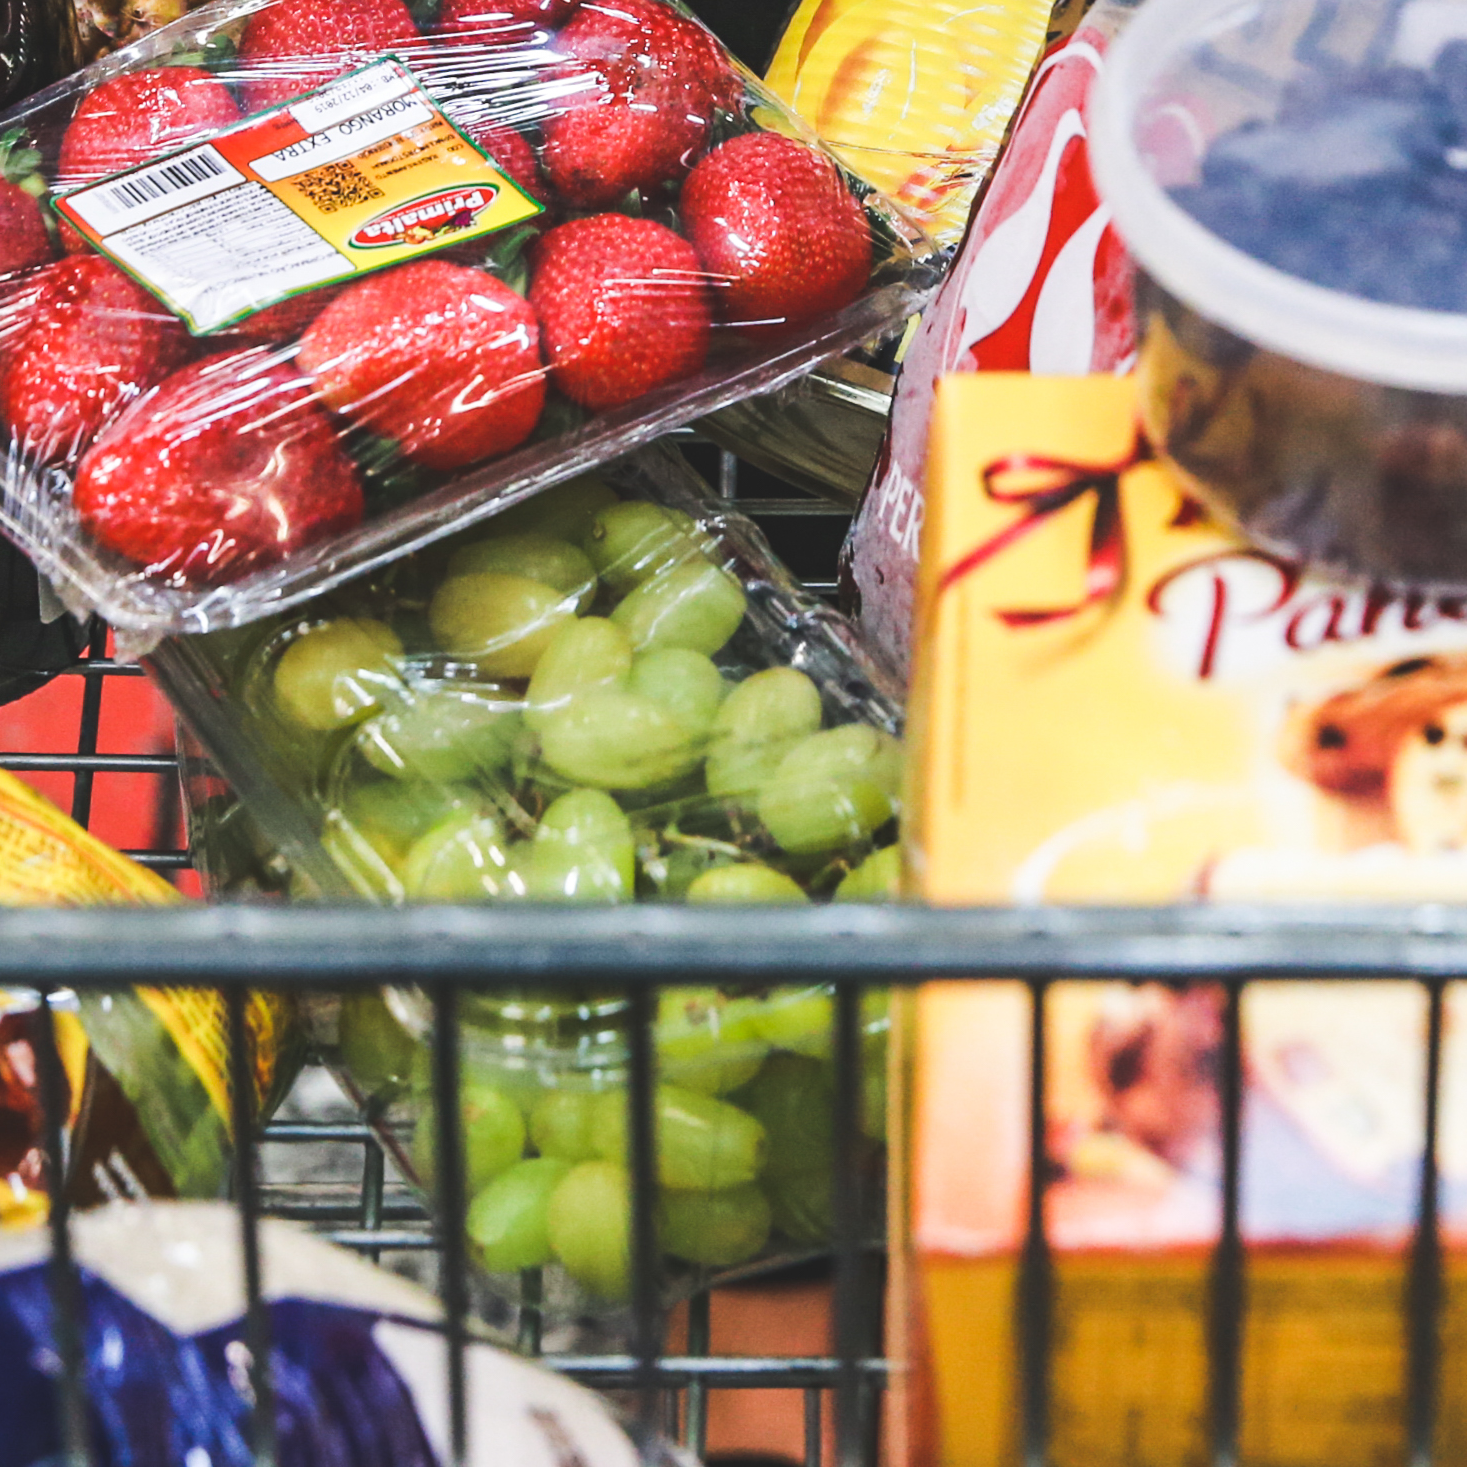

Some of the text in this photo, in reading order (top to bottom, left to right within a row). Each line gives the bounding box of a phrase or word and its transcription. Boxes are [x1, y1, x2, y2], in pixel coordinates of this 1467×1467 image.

[338, 94, 419, 135] MORANGO
[271, 131, 332, 162] EXTRA
[363, 191, 485, 238] Primalta
